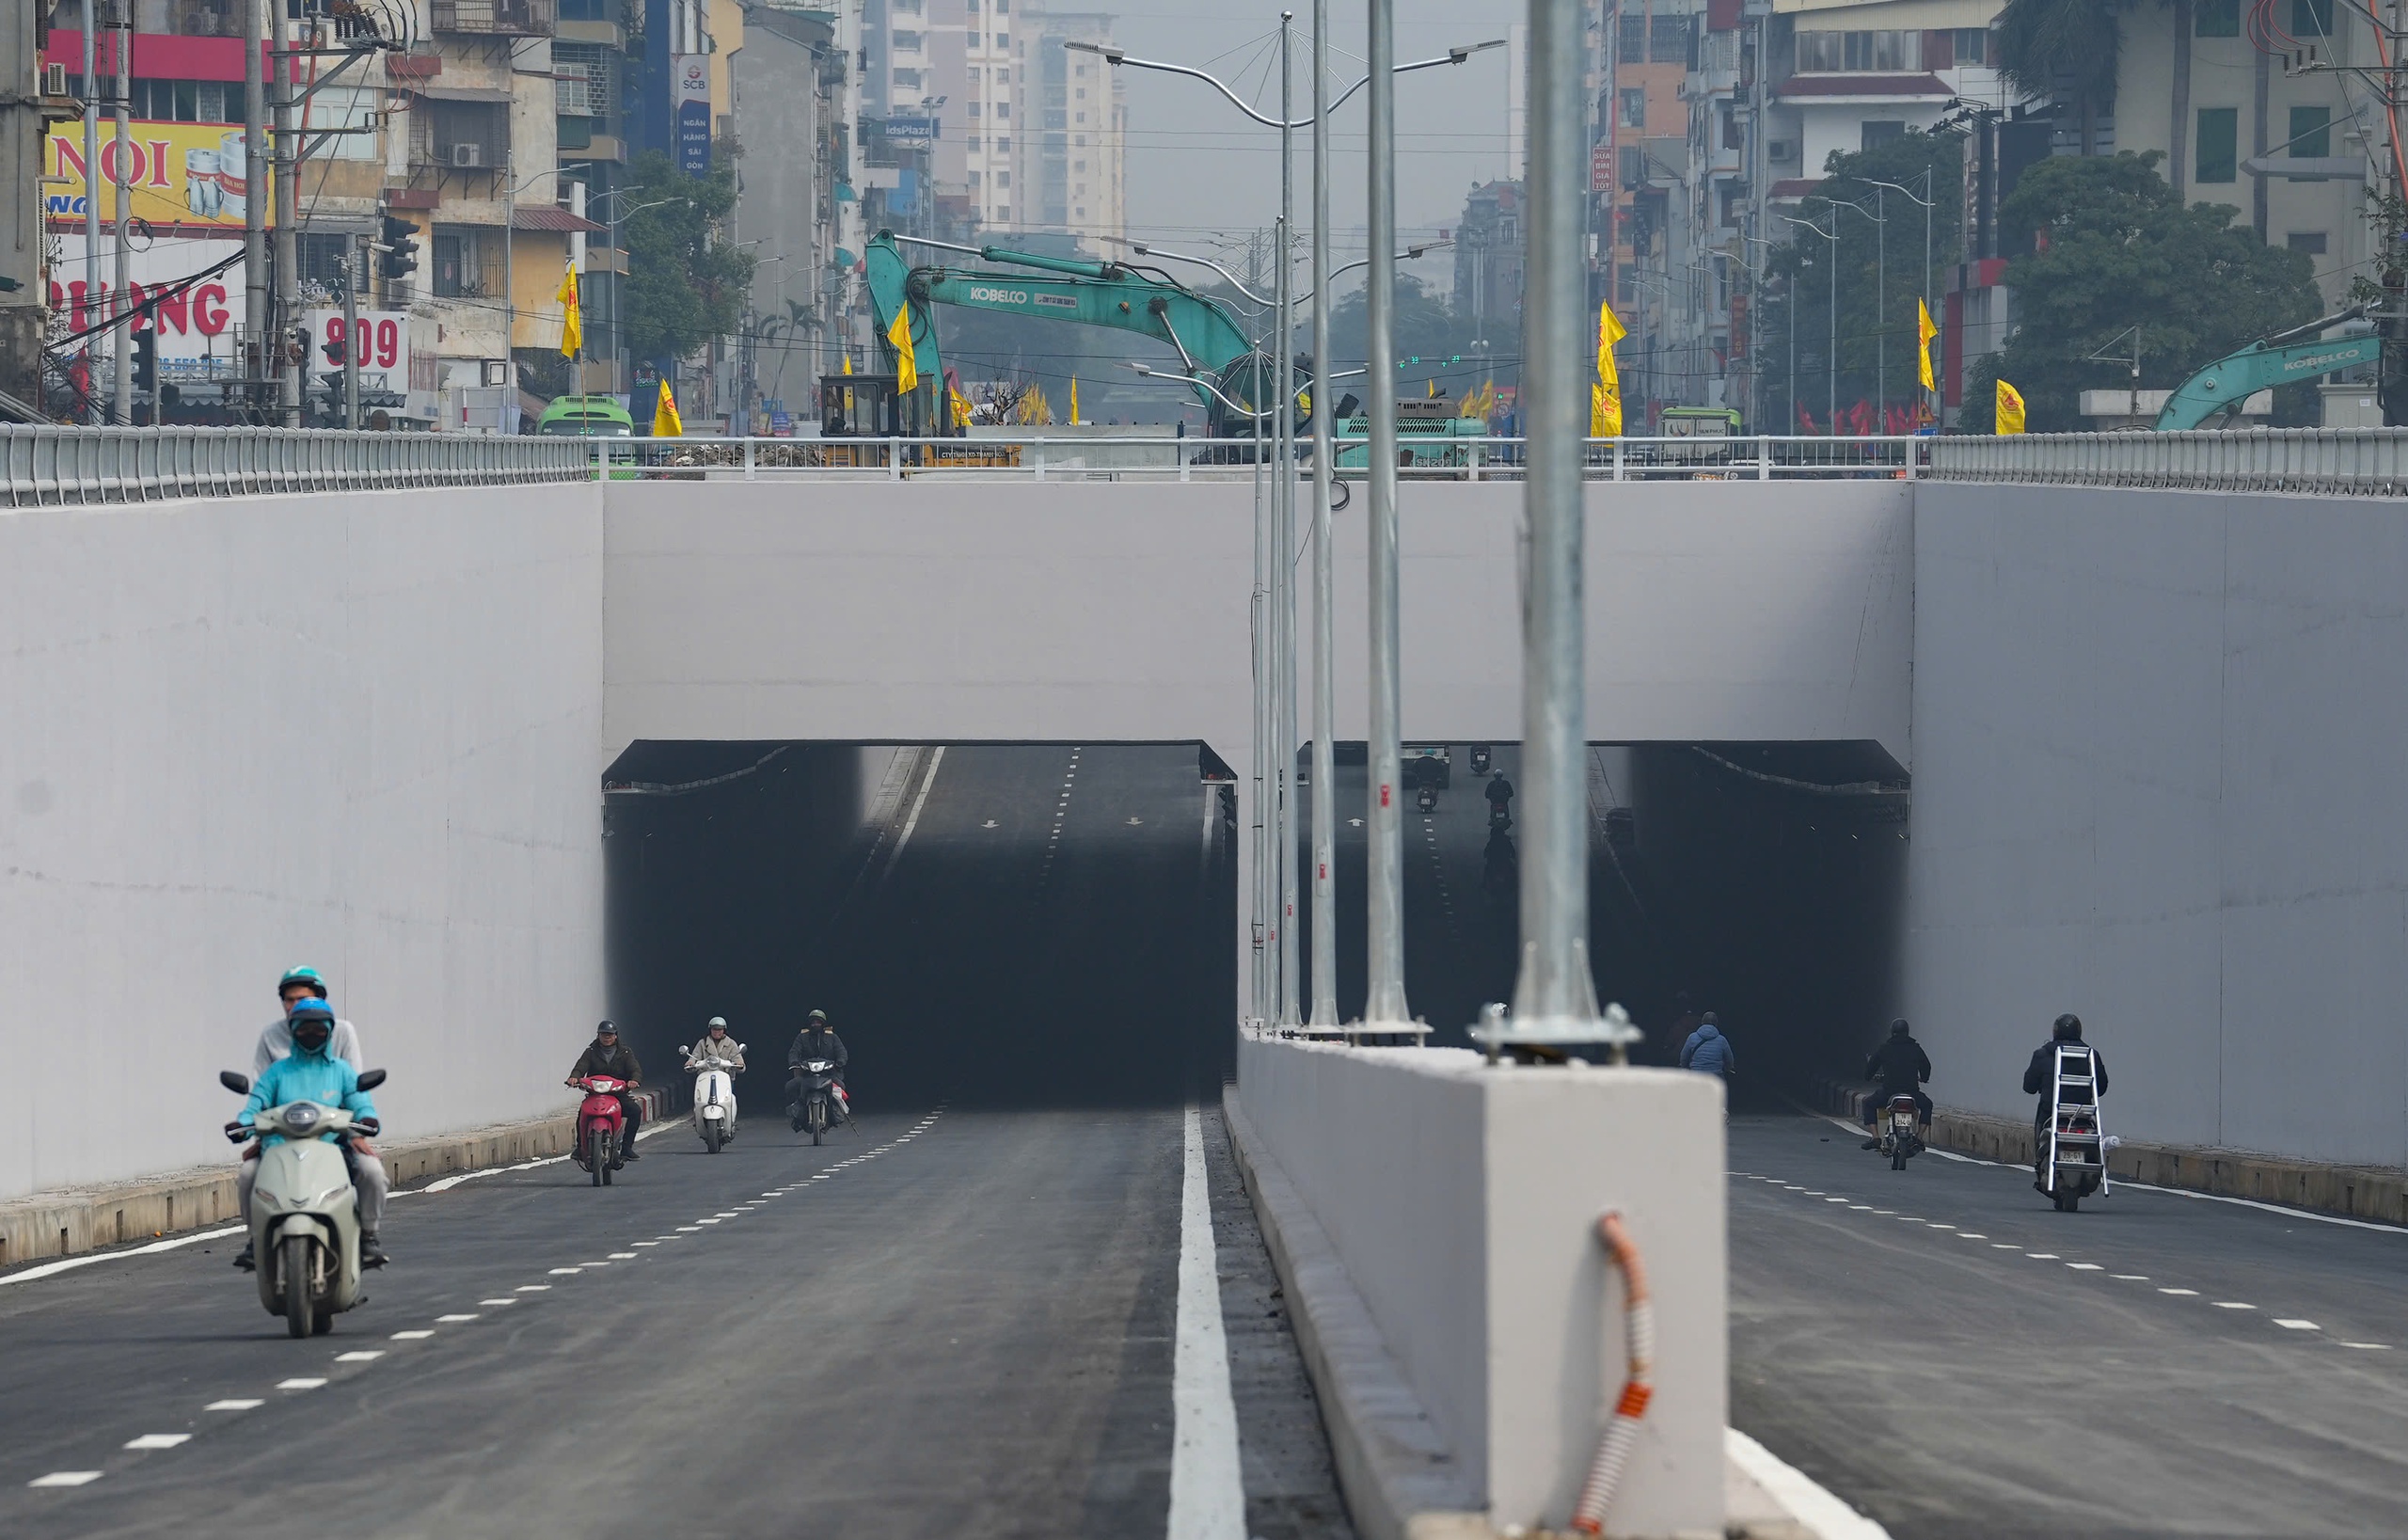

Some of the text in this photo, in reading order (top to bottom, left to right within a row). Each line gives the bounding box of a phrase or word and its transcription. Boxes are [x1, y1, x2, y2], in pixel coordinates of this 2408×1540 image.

[304, 30, 322, 42] 89
[683, 80, 705, 89] SCB
[885, 125, 930, 135] idsPlaza
[44, 195, 87, 214] NG
[970, 287, 1027, 305] KOBELCO
[2284, 349, 2359, 371] KOBELCO
